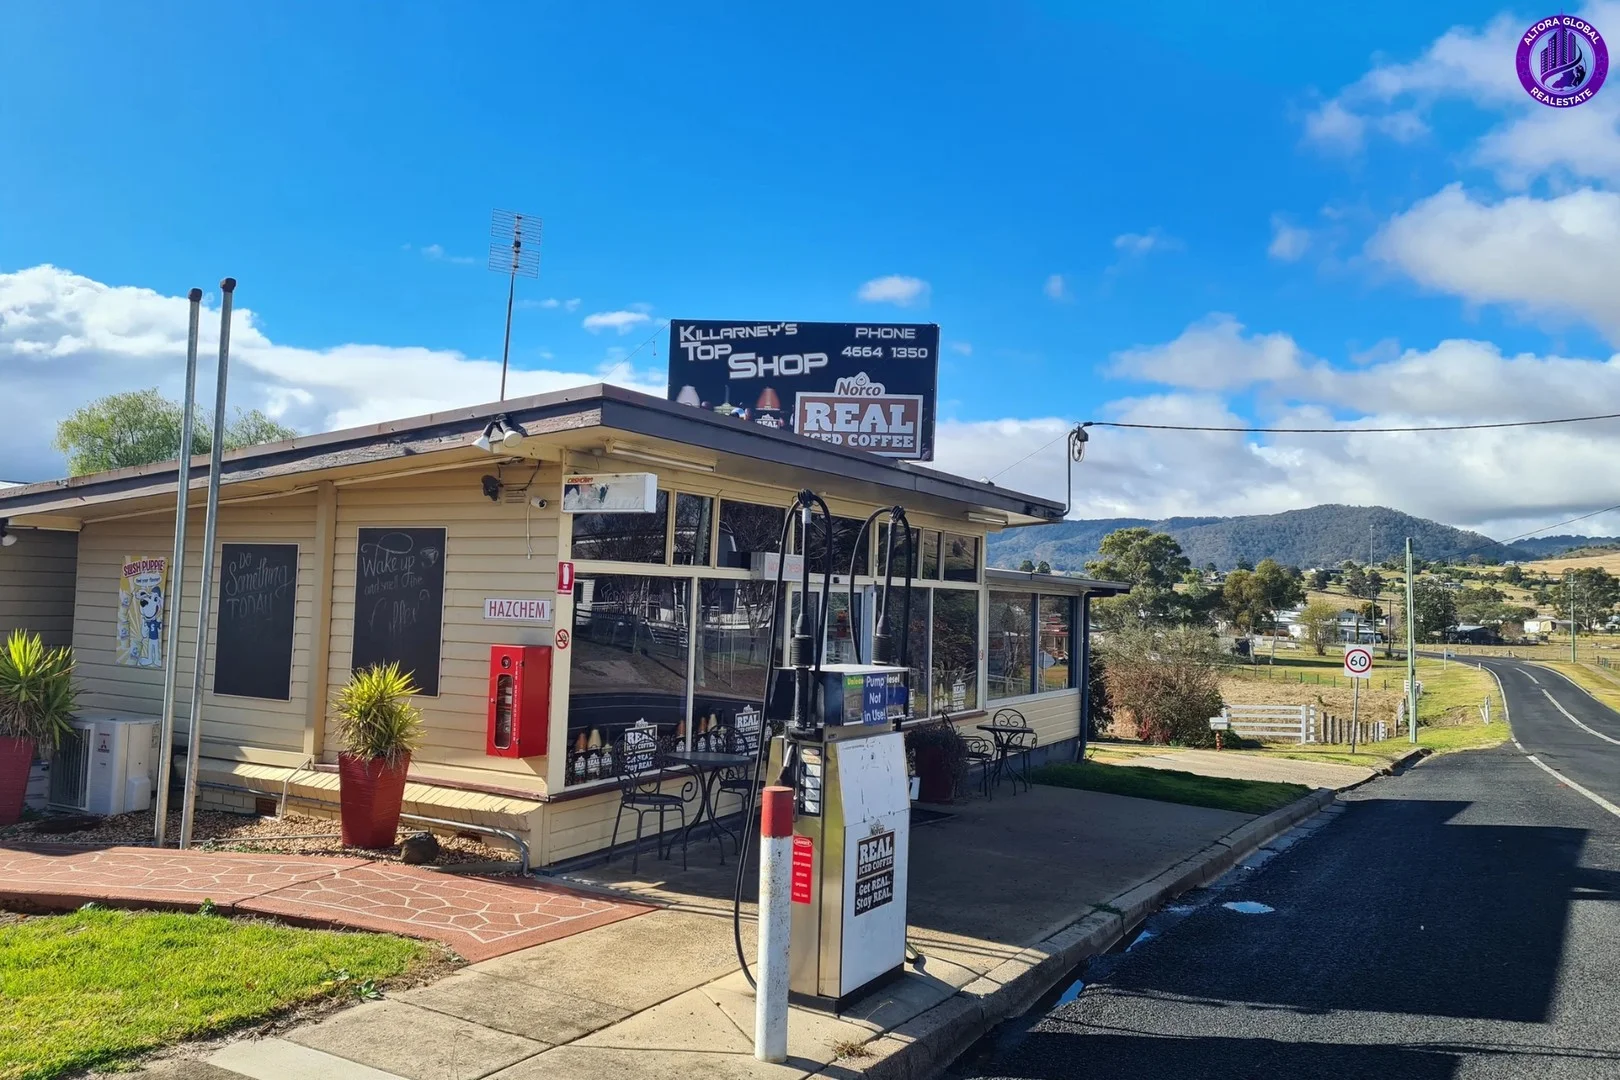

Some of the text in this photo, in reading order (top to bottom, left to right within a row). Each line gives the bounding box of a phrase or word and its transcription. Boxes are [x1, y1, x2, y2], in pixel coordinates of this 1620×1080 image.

[680, 323, 798, 342] KILLARNEY'S
[856, 328, 916, 338] PHONE
[680, 341, 732, 361] TOP
[842, 346, 928, 358] 4664 1350
[728, 352, 828, 378] SHOP
[838, 381, 881, 396] Norco
[804, 402, 914, 434] REAL
[848, 434, 914, 448] COFFEE
[361, 541, 400, 576] Wake
[142, 560, 164, 573] PUPPIE
[226, 557, 292, 597] Something
[489, 600, 545, 618] HAZCHEM
[1350, 656, 1367, 666] 60
[866, 676, 884, 688] Pump
[869, 692, 881, 704] Not
[737, 714, 759, 728] REAL
[864, 708, 886, 722] in Use!
[860, 836, 892, 865] REAL
[859, 856, 892, 875] ICED COFFEE
[859, 882, 870, 896] Get
[856, 896, 873, 909] Stay
